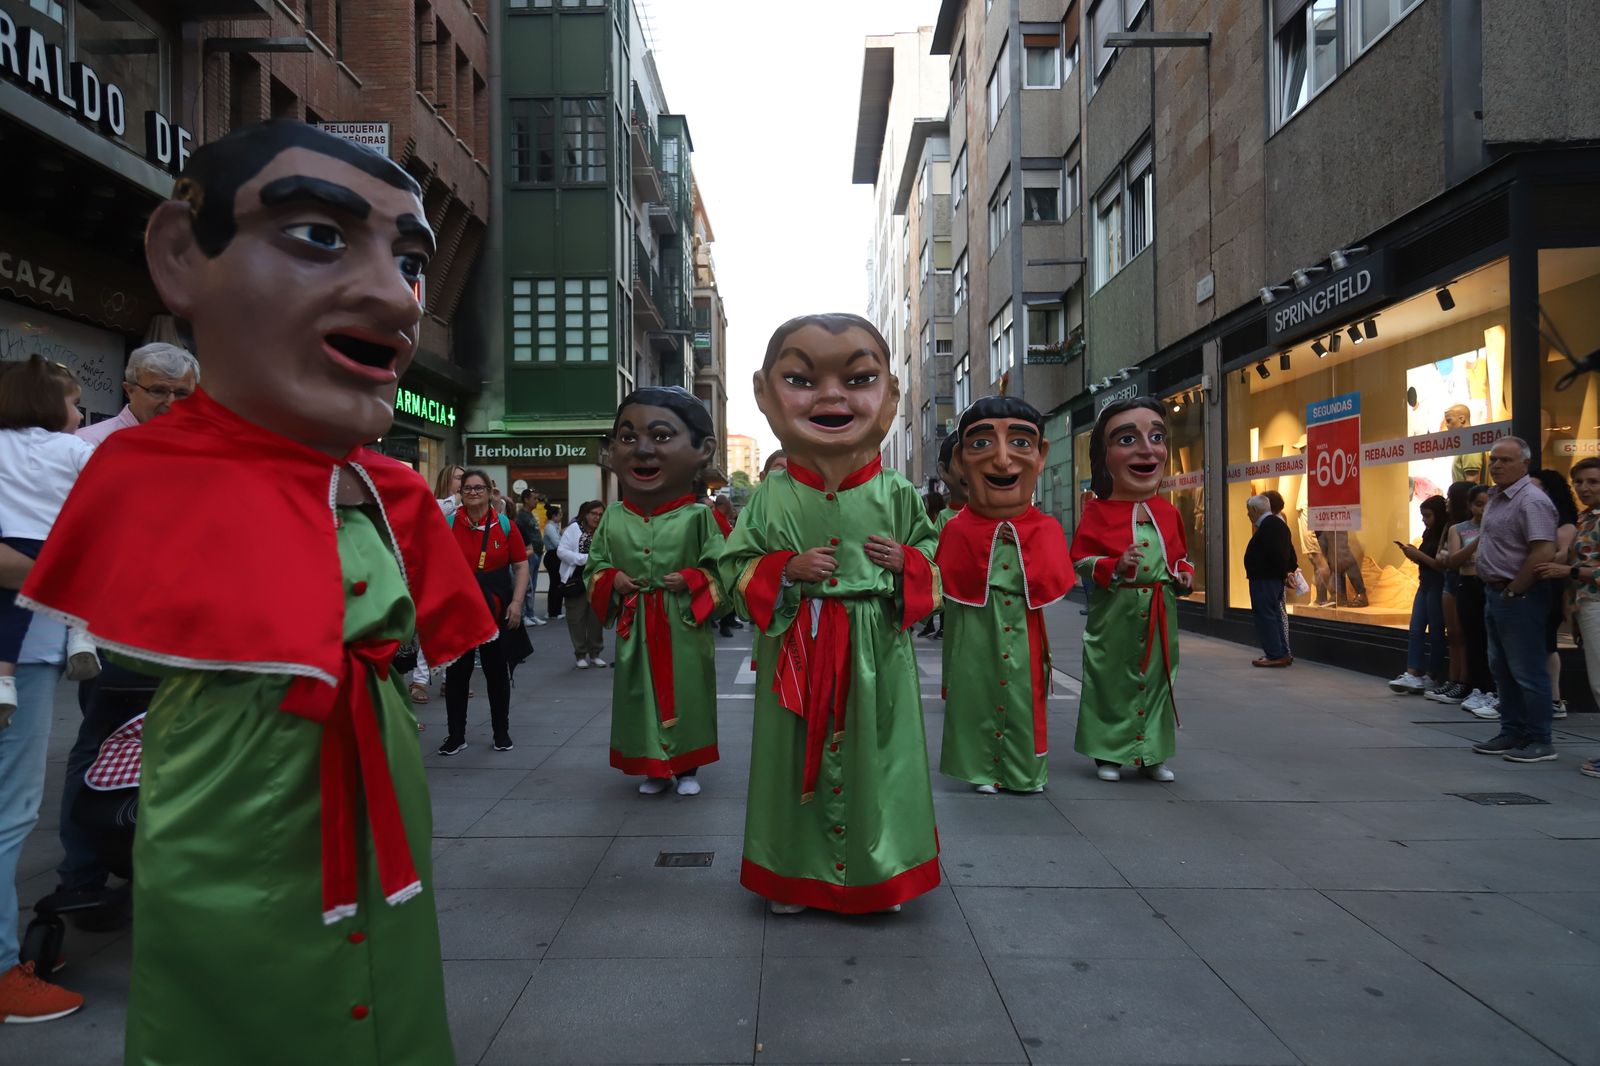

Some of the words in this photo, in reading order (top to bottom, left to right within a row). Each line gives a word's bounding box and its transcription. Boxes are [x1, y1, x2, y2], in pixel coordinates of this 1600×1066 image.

[0, 8, 125, 136] RALDO
[324, 124, 384, 134] PELUQUERIA
[0, 252, 75, 302] CAZA
[1275, 269, 1371, 333] SPRINGFIELD
[395, 387, 447, 426] ARMACIA
[1313, 399, 1353, 418] SEGUNDAS
[474, 444, 551, 457] Herbolario
[555, 443, 587, 456] Diez
[1364, 444, 1404, 461] REBAJAS
[1413, 435, 1461, 454] REBAJAS
[1226, 468, 1241, 478] AJAS
[1245, 464, 1270, 477] REBAJAS
[1275, 459, 1304, 472] REBAJAS
[1310, 448, 1358, 487] -60%
[1331, 510, 1351, 521] EXTRA
